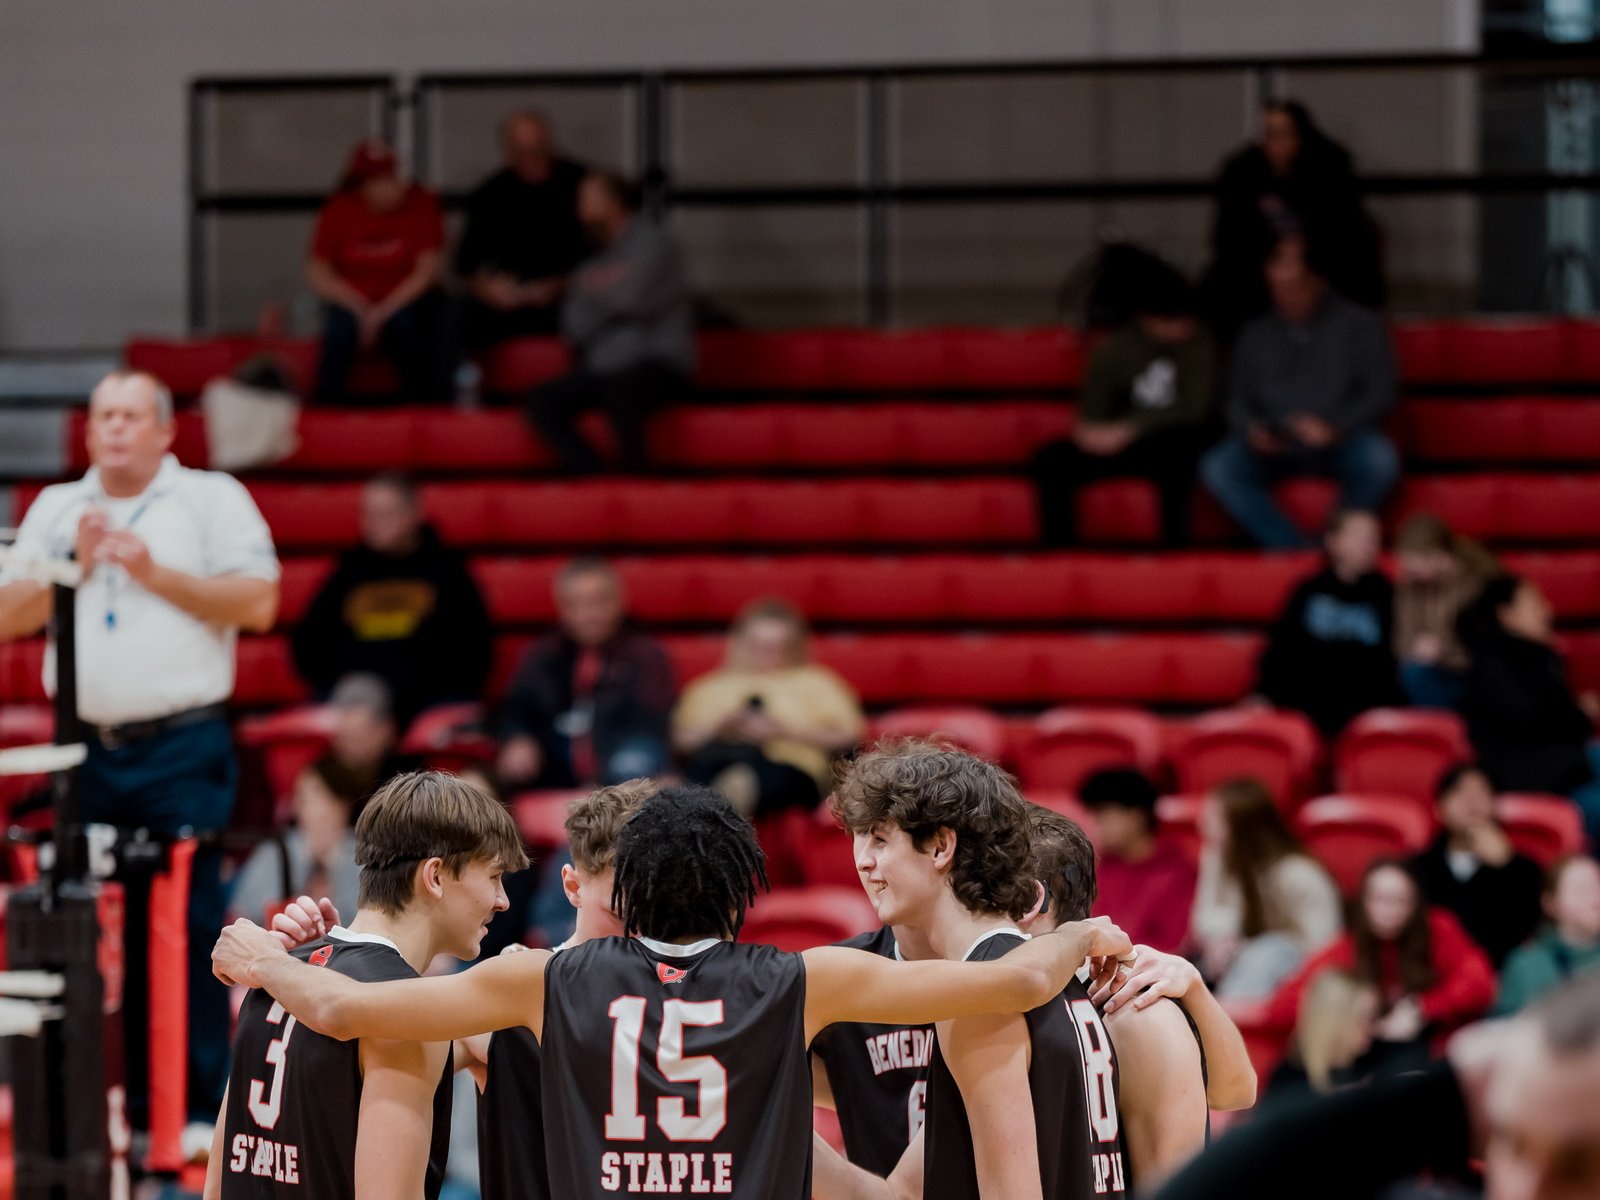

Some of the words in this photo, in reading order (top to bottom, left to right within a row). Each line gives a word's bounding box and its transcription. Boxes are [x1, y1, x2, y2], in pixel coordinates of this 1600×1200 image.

[247, 1000, 297, 1130] 3
[604, 994, 728, 1142] 15
[601, 1151, 733, 1193] STAPLE
